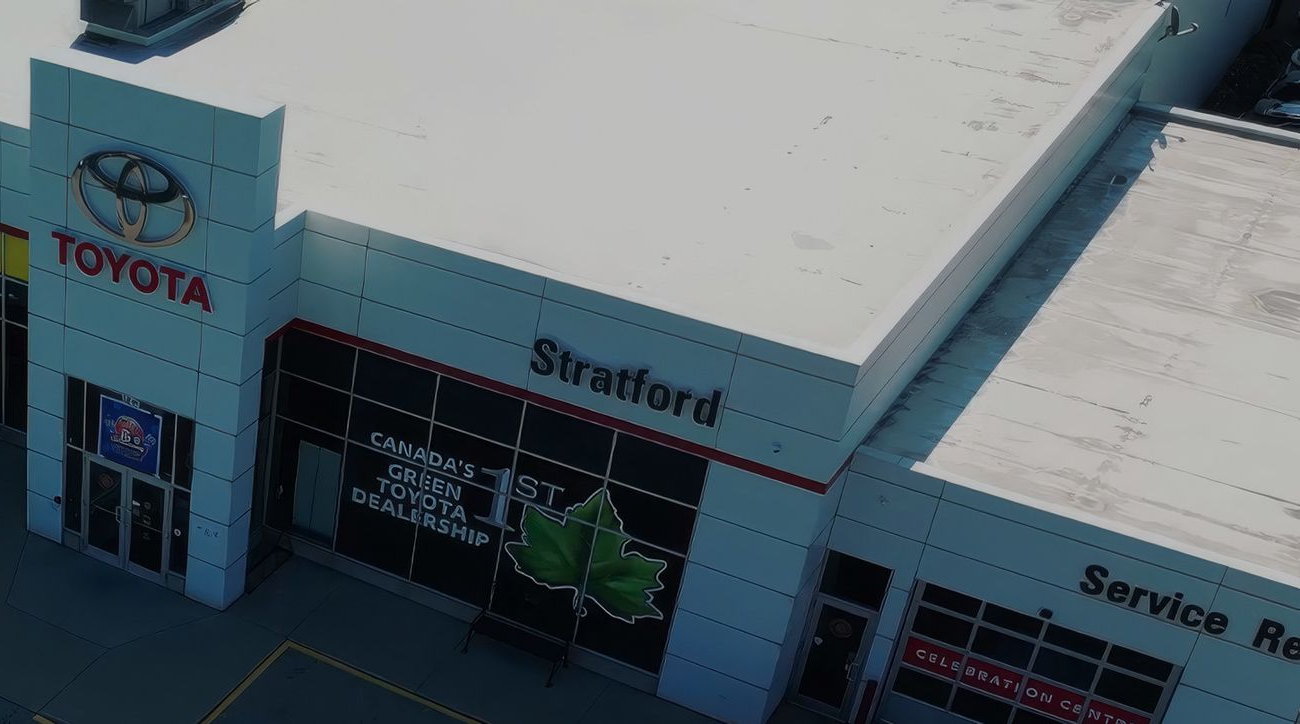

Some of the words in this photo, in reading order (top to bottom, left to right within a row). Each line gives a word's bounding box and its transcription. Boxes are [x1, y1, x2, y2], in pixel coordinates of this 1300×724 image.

[51, 231, 213, 313] TOYOTA
[530, 338, 722, 428] Stratford
[369, 431, 476, 479] CANADA'S
[387, 463, 462, 502] GREEN
[351, 487, 490, 547] DEALERSHIP
[376, 476, 467, 524] TOYOTA
[1079, 564, 1229, 635] Service
[1252, 618, 1300, 661] Re
[914, 649, 1053, 704] CELEBRATION
